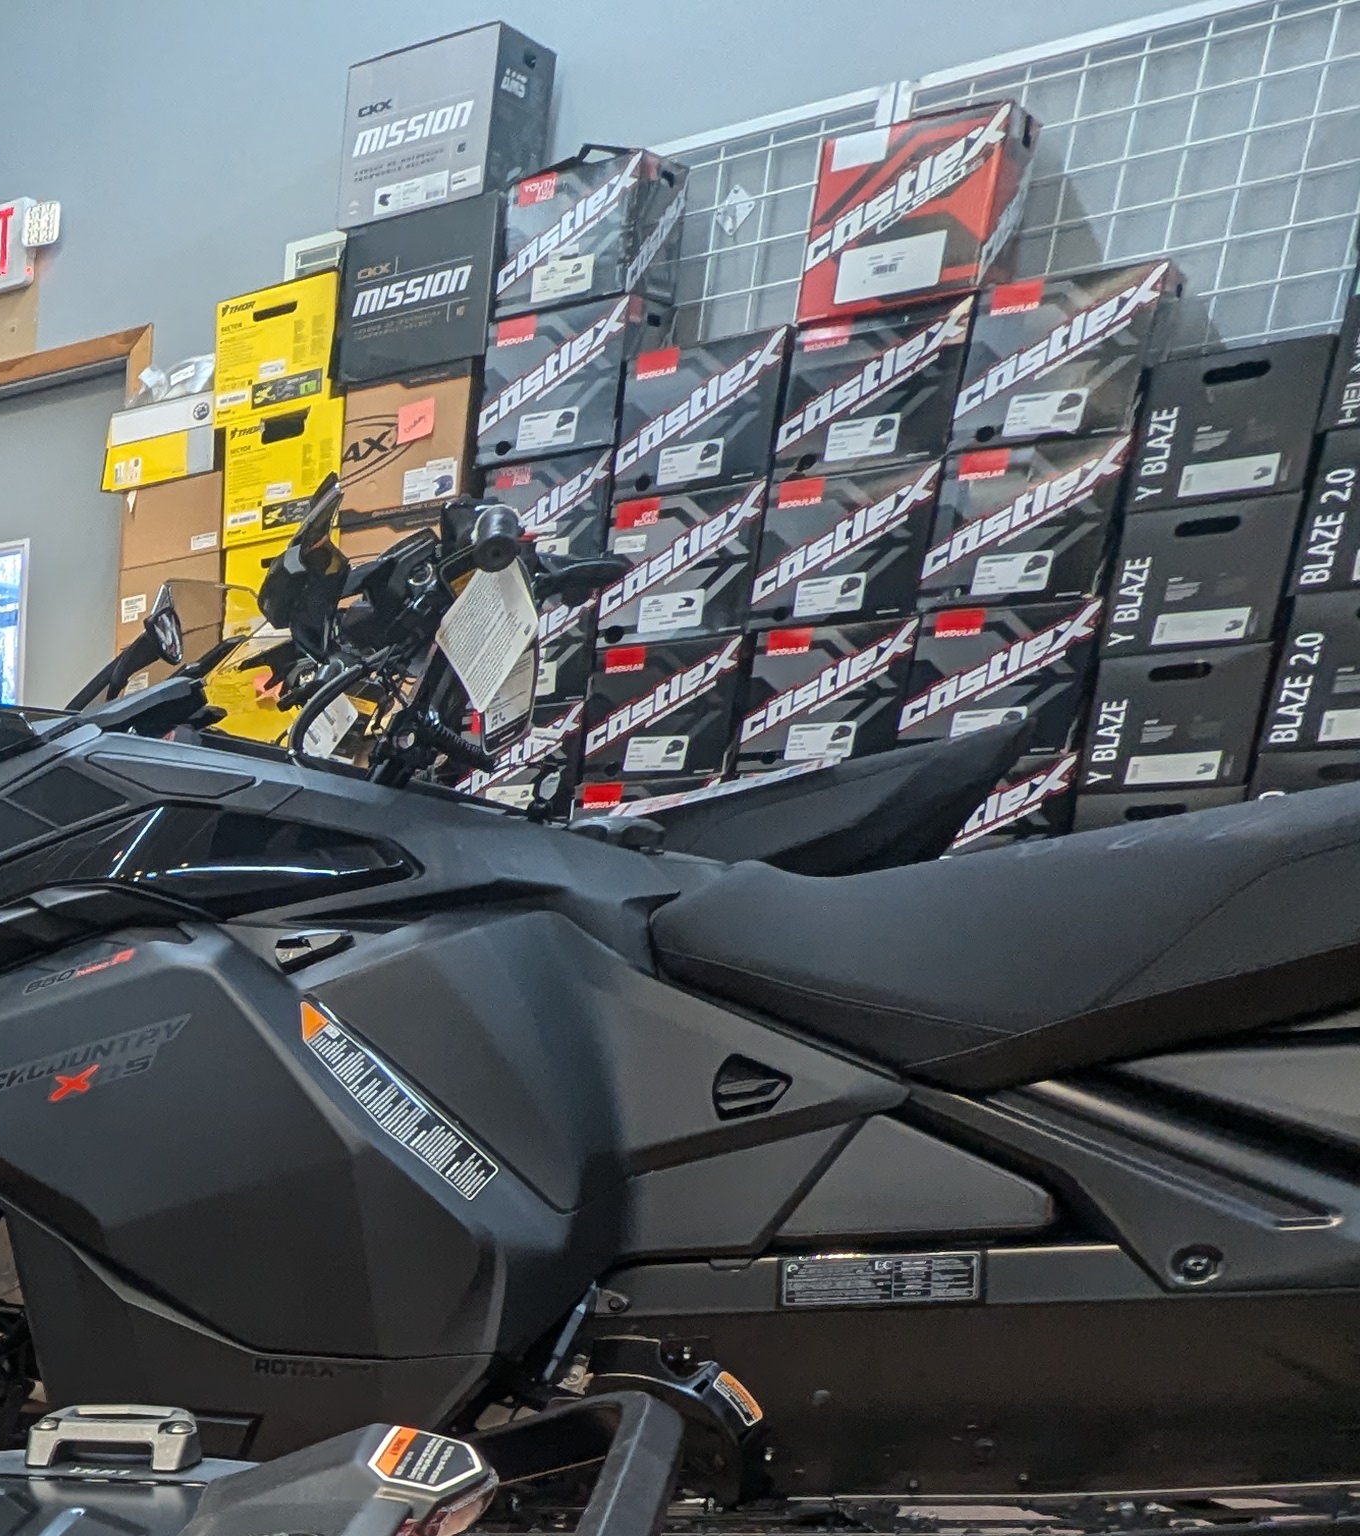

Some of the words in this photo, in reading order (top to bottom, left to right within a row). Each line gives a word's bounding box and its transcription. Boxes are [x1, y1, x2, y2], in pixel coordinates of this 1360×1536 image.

[358, 99, 392, 117] CKX
[358, 263, 391, 280] CKX
[229, 301, 256, 314] THOR
[1141, 407, 1180, 476] BLAZE
[958, 468, 1005, 481] MODULAR
[1135, 486, 1163, 502] Y
[778, 496, 821, 510] MODULAR
[1299, 510, 1345, 587] BLAZE
[1325, 467, 1357, 504] 2.0
[1113, 556, 1153, 622] BLAZE
[935, 628, 980, 638] MODULAR
[1107, 631, 1135, 648] Y
[767, 647, 809, 656] MODULAR
[1290, 631, 1326, 664] 2.0
[605, 663, 644, 674] MODULAR
[1269, 666, 1314, 744] BLAZE
[1092, 699, 1128, 761] BLAZE
[1086, 770, 1112, 786] Y
